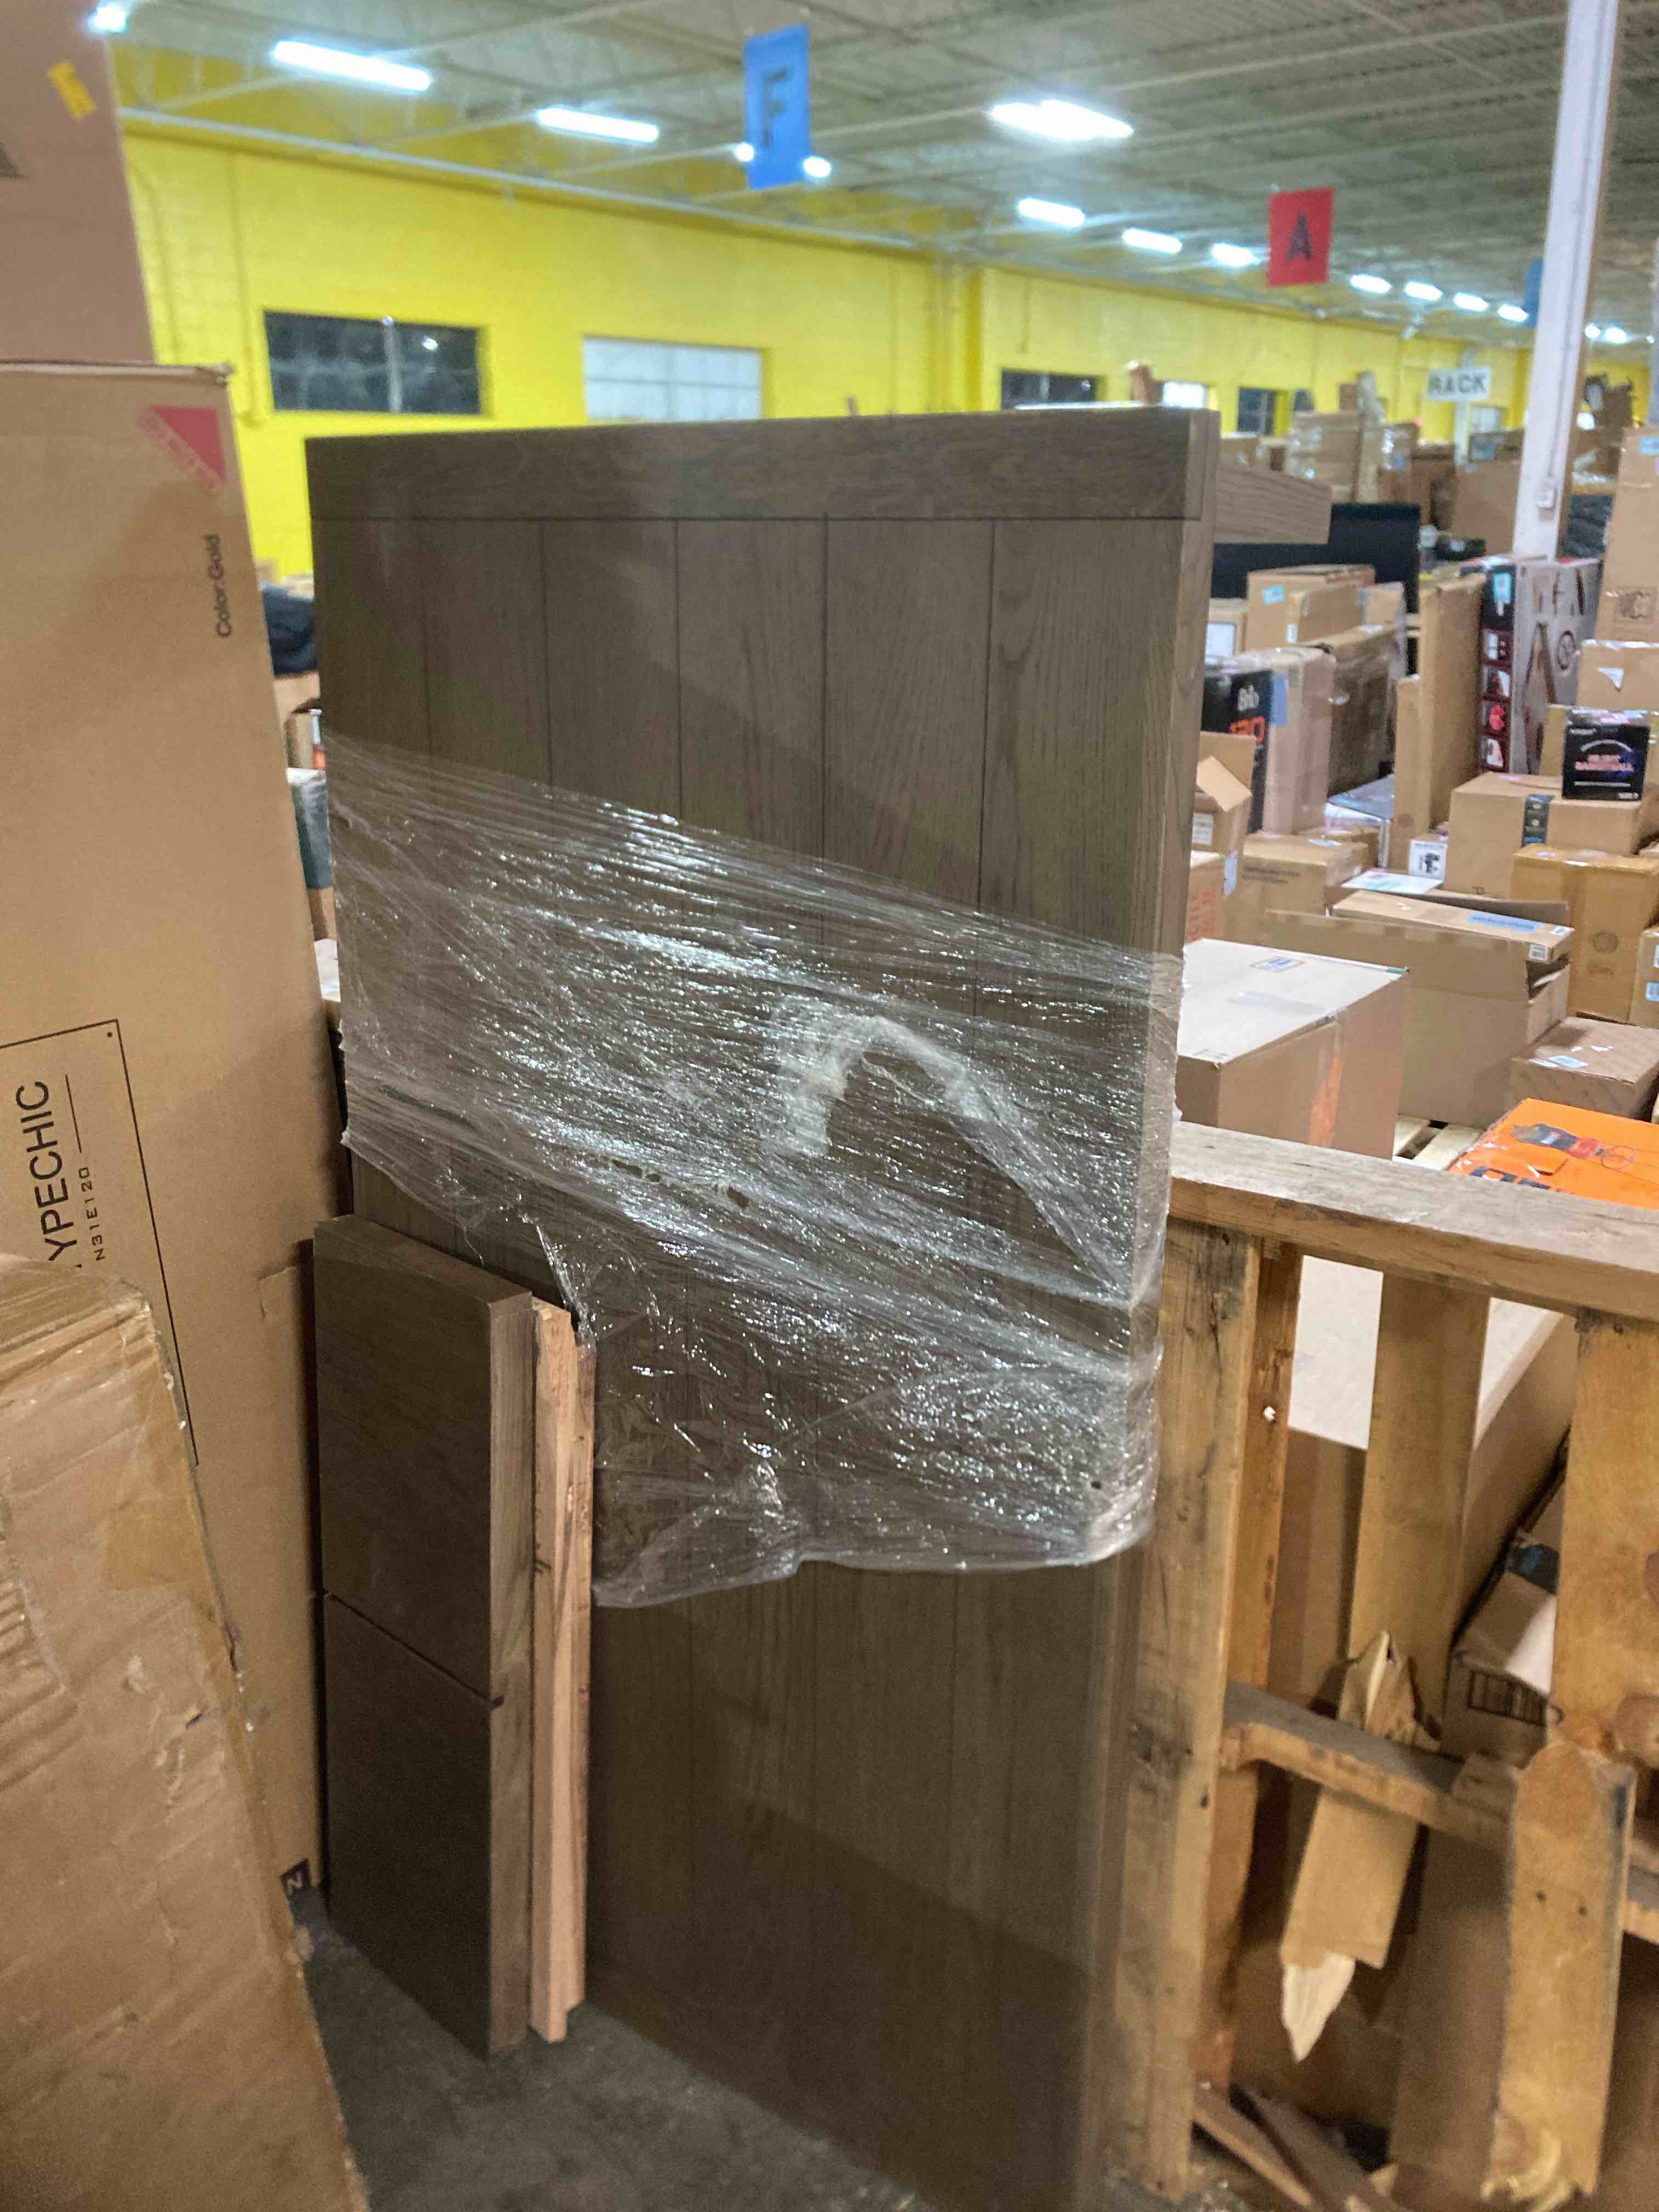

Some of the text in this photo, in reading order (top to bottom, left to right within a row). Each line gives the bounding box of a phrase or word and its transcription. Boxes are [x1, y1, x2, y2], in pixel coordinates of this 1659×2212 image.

[761, 67, 790, 149] F
[1286, 211, 1313, 261] A
[1427, 375, 1488, 395] RACK
[15, 1081, 82, 1268] YPECHIC
